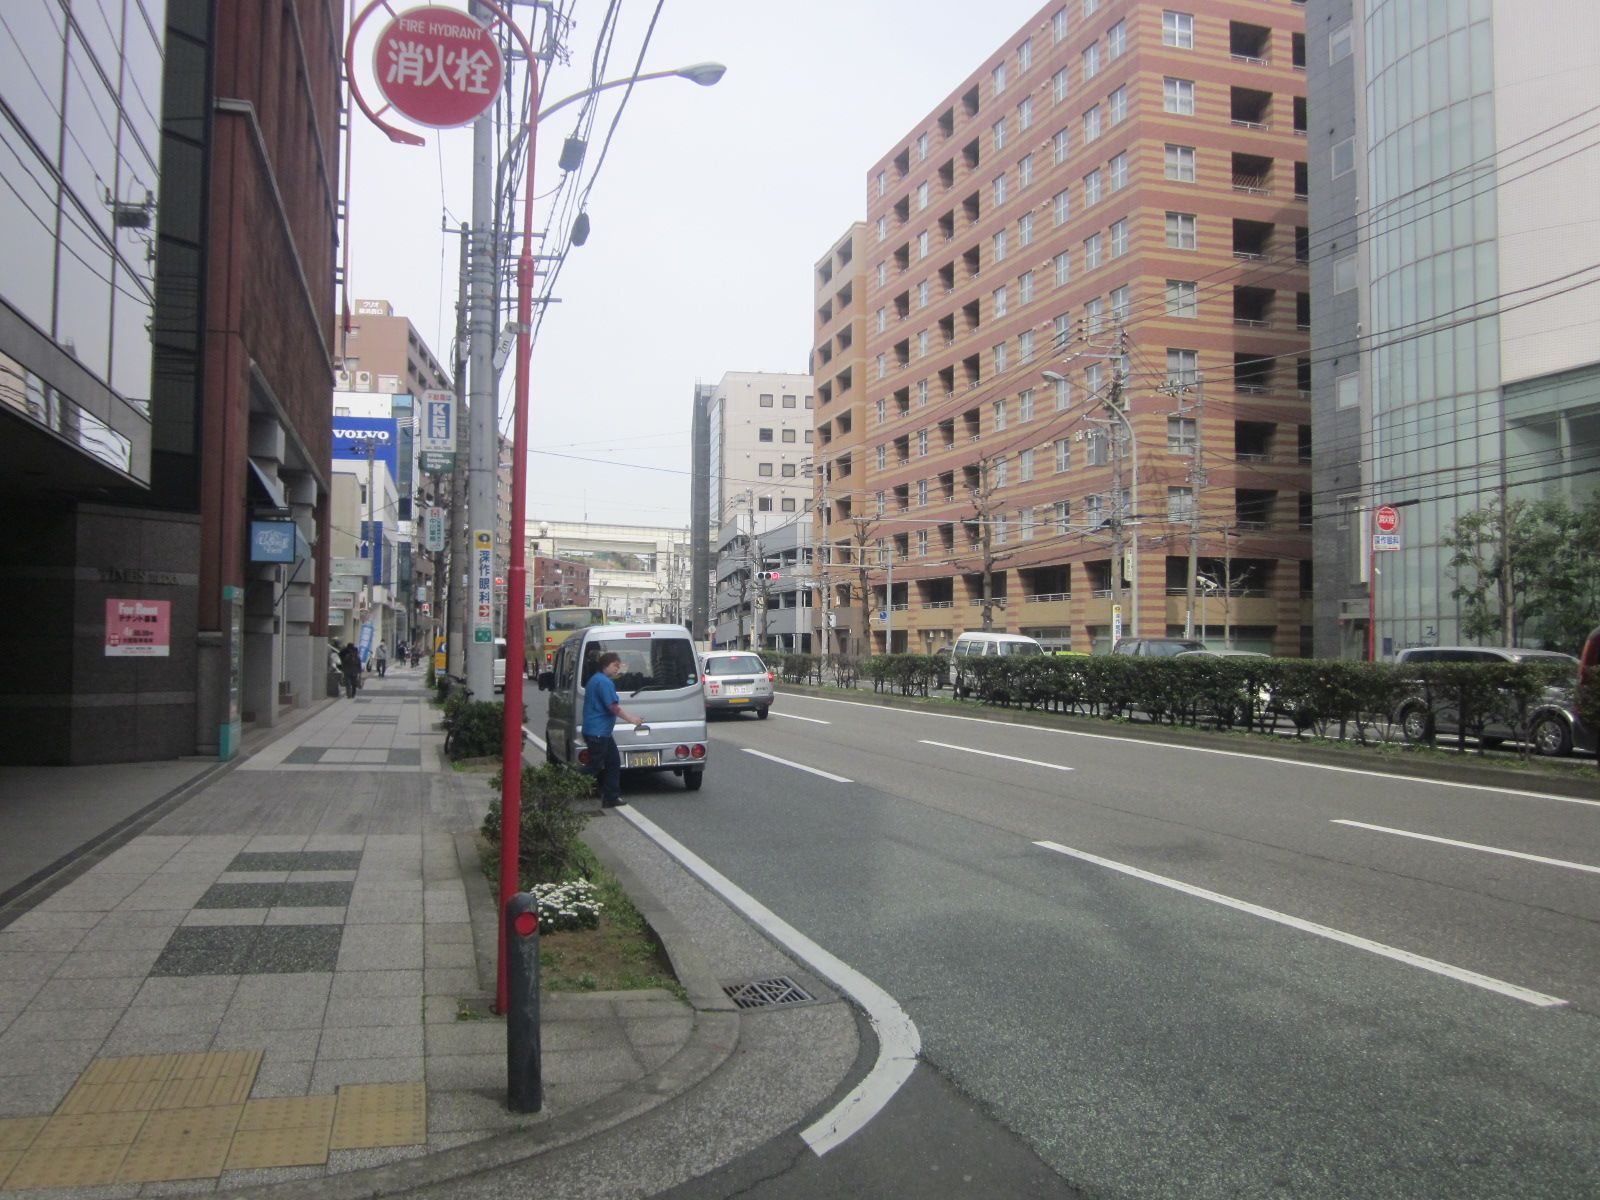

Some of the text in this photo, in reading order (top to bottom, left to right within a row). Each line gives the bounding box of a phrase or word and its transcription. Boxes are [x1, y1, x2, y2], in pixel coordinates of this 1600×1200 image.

[399, 19, 482, 40] FIRE HYDRANT
[386, 39, 492, 94] 消火栓
[332, 429, 389, 440] VOLVO
[432, 403, 447, 438] KEN
[479, 550, 490, 604] 深作眼科
